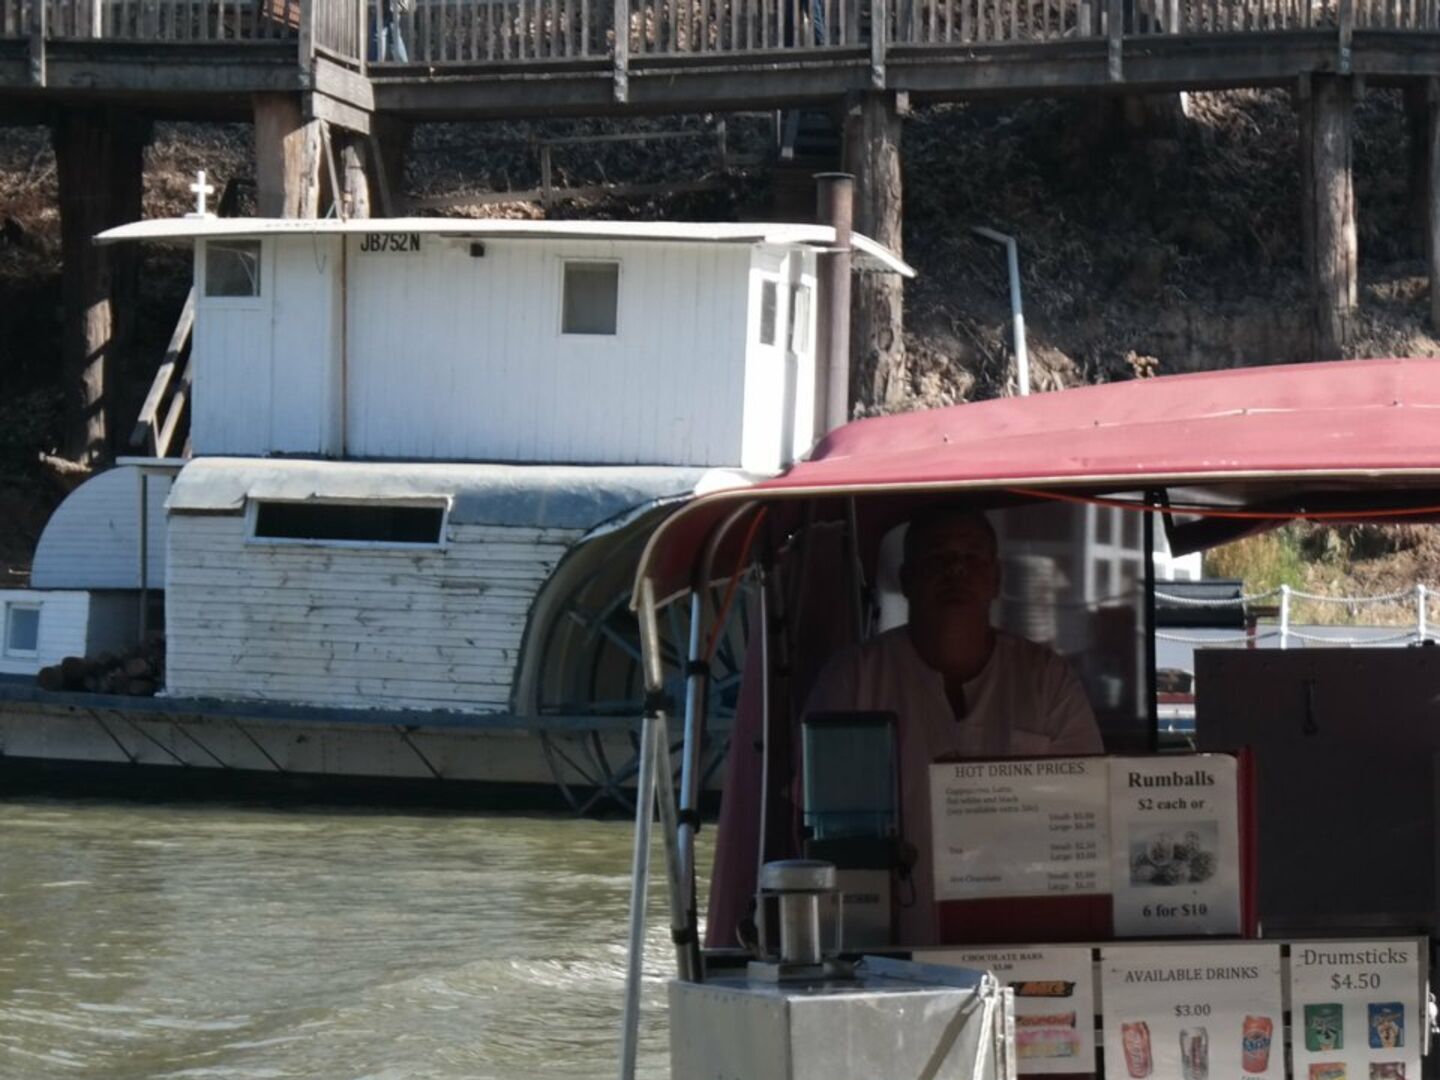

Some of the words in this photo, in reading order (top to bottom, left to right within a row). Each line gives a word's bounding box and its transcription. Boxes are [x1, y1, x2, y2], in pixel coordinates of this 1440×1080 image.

[360, 232, 420, 252] JB752N
[955, 765, 985, 778] HOT
[988, 763, 1033, 777] DRINK
[1036, 761, 1086, 776] PRICES
[1128, 770, 1215, 788] Rumballs
[1138, 798, 1153, 811] $2
[1157, 797, 1187, 810] each
[1190, 799, 1205, 810] or
[1143, 904, 1152, 917] 6
[1156, 903, 1179, 917] for
[1181, 903, 1208, 917] $10
[961, 952, 1018, 961] CHOCOLATE
[1304, 948, 1407, 966] Drumsticks
[1125, 969, 1202, 983] AVAILABLE
[1206, 966, 1260, 981] DRINKS
[1331, 972, 1381, 990] $4.50
[1175, 1003, 1211, 1017] $3.00
